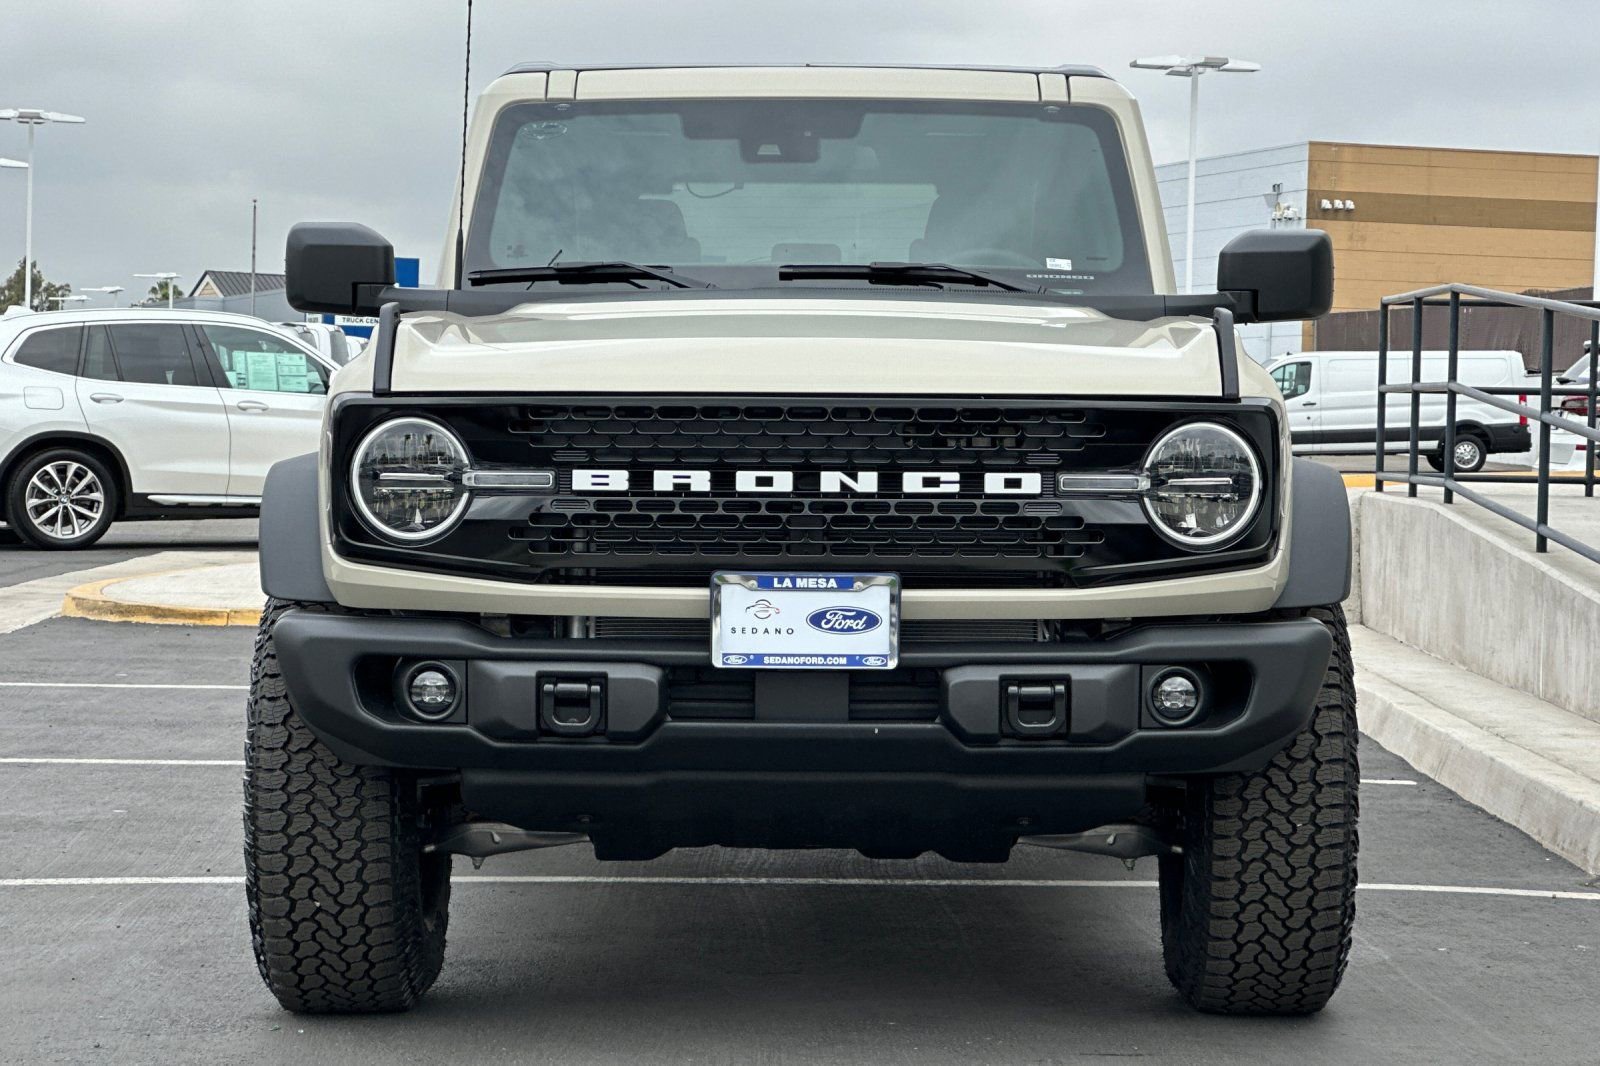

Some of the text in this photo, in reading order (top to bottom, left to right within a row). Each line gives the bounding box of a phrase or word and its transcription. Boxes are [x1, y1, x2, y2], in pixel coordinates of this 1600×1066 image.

[572, 469, 1041, 494] BRONCO
[773, 578, 838, 588] LA MESA
[821, 610, 867, 630] Ford
[731, 626, 795, 635] SEDANO
[763, 656, 847, 665] SEDANOFORD.COM
